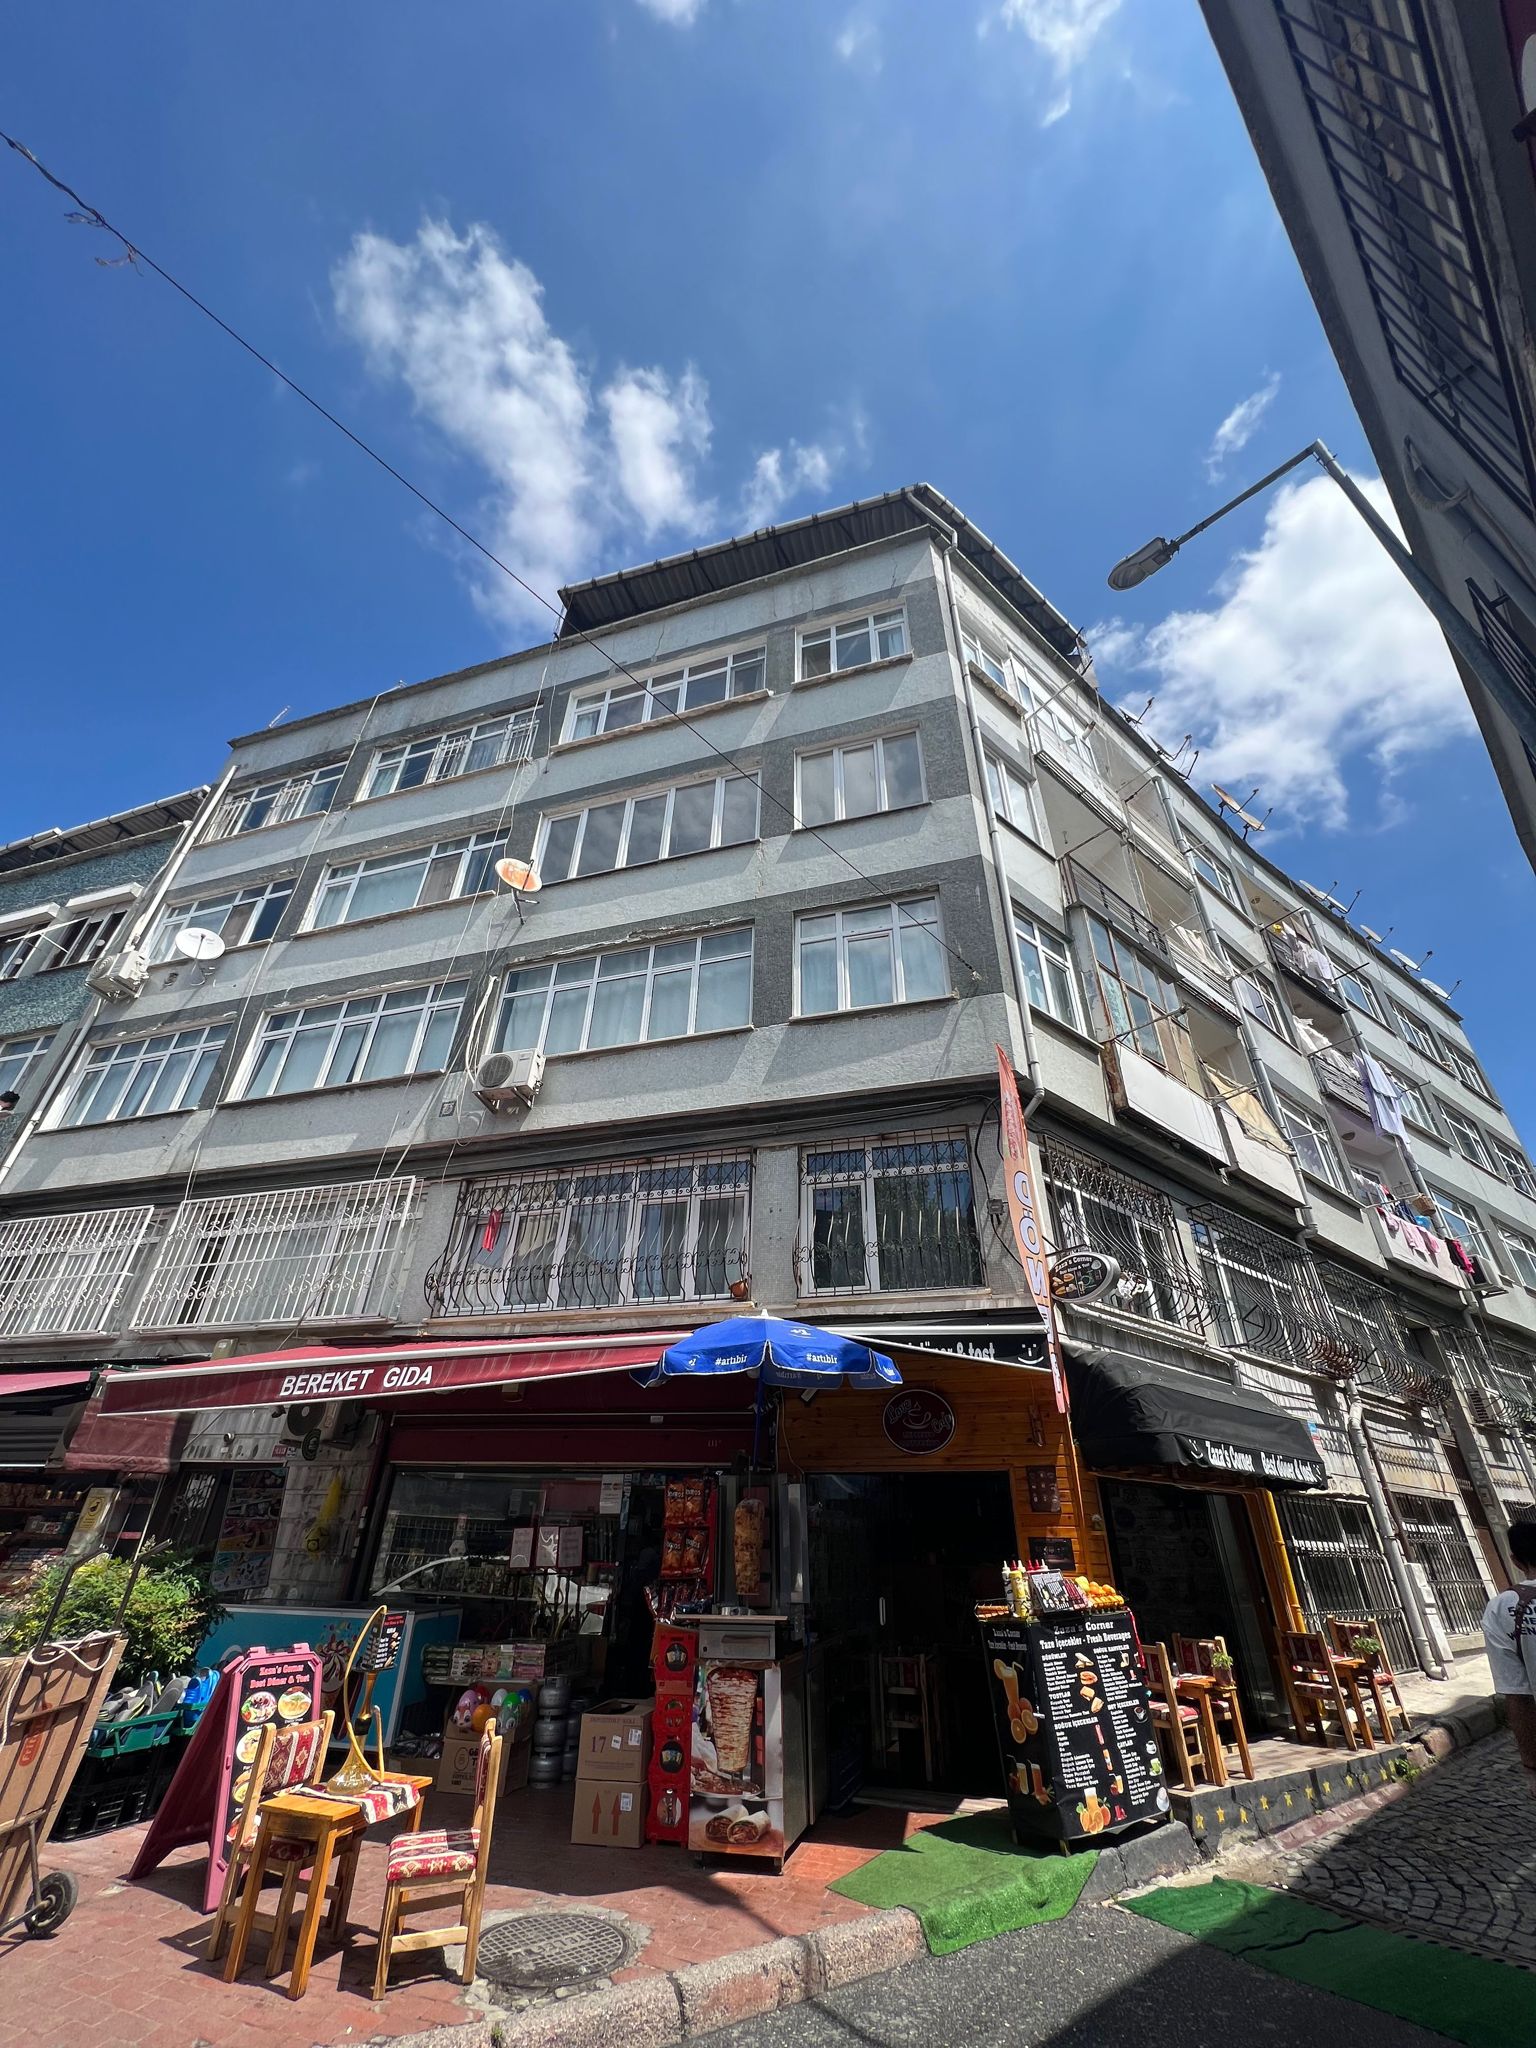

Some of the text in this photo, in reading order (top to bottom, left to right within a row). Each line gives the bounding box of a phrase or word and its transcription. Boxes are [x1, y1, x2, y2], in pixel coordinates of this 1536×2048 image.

[968, 1342, 995, 1360] tost
[279, 1365, 434, 1397] BEREKET GIDA
[1205, 1440, 1232, 1468] Zaza's
[1229, 1445, 1255, 1472] Corner
[1260, 1451, 1279, 1477] Best
[1293, 1458, 1304, 1481] &
[1299, 1459, 1318, 1483] tost
[1053, 1621, 1114, 1635] Zaza's Corner
[1039, 1639, 1055, 1650] Taze
[1086, 1634, 1102, 1644] Fresh
[1102, 1632, 1132, 1642] Beverages
[288, 1675, 295, 1684] &
[592, 1736, 606, 1753] 17
